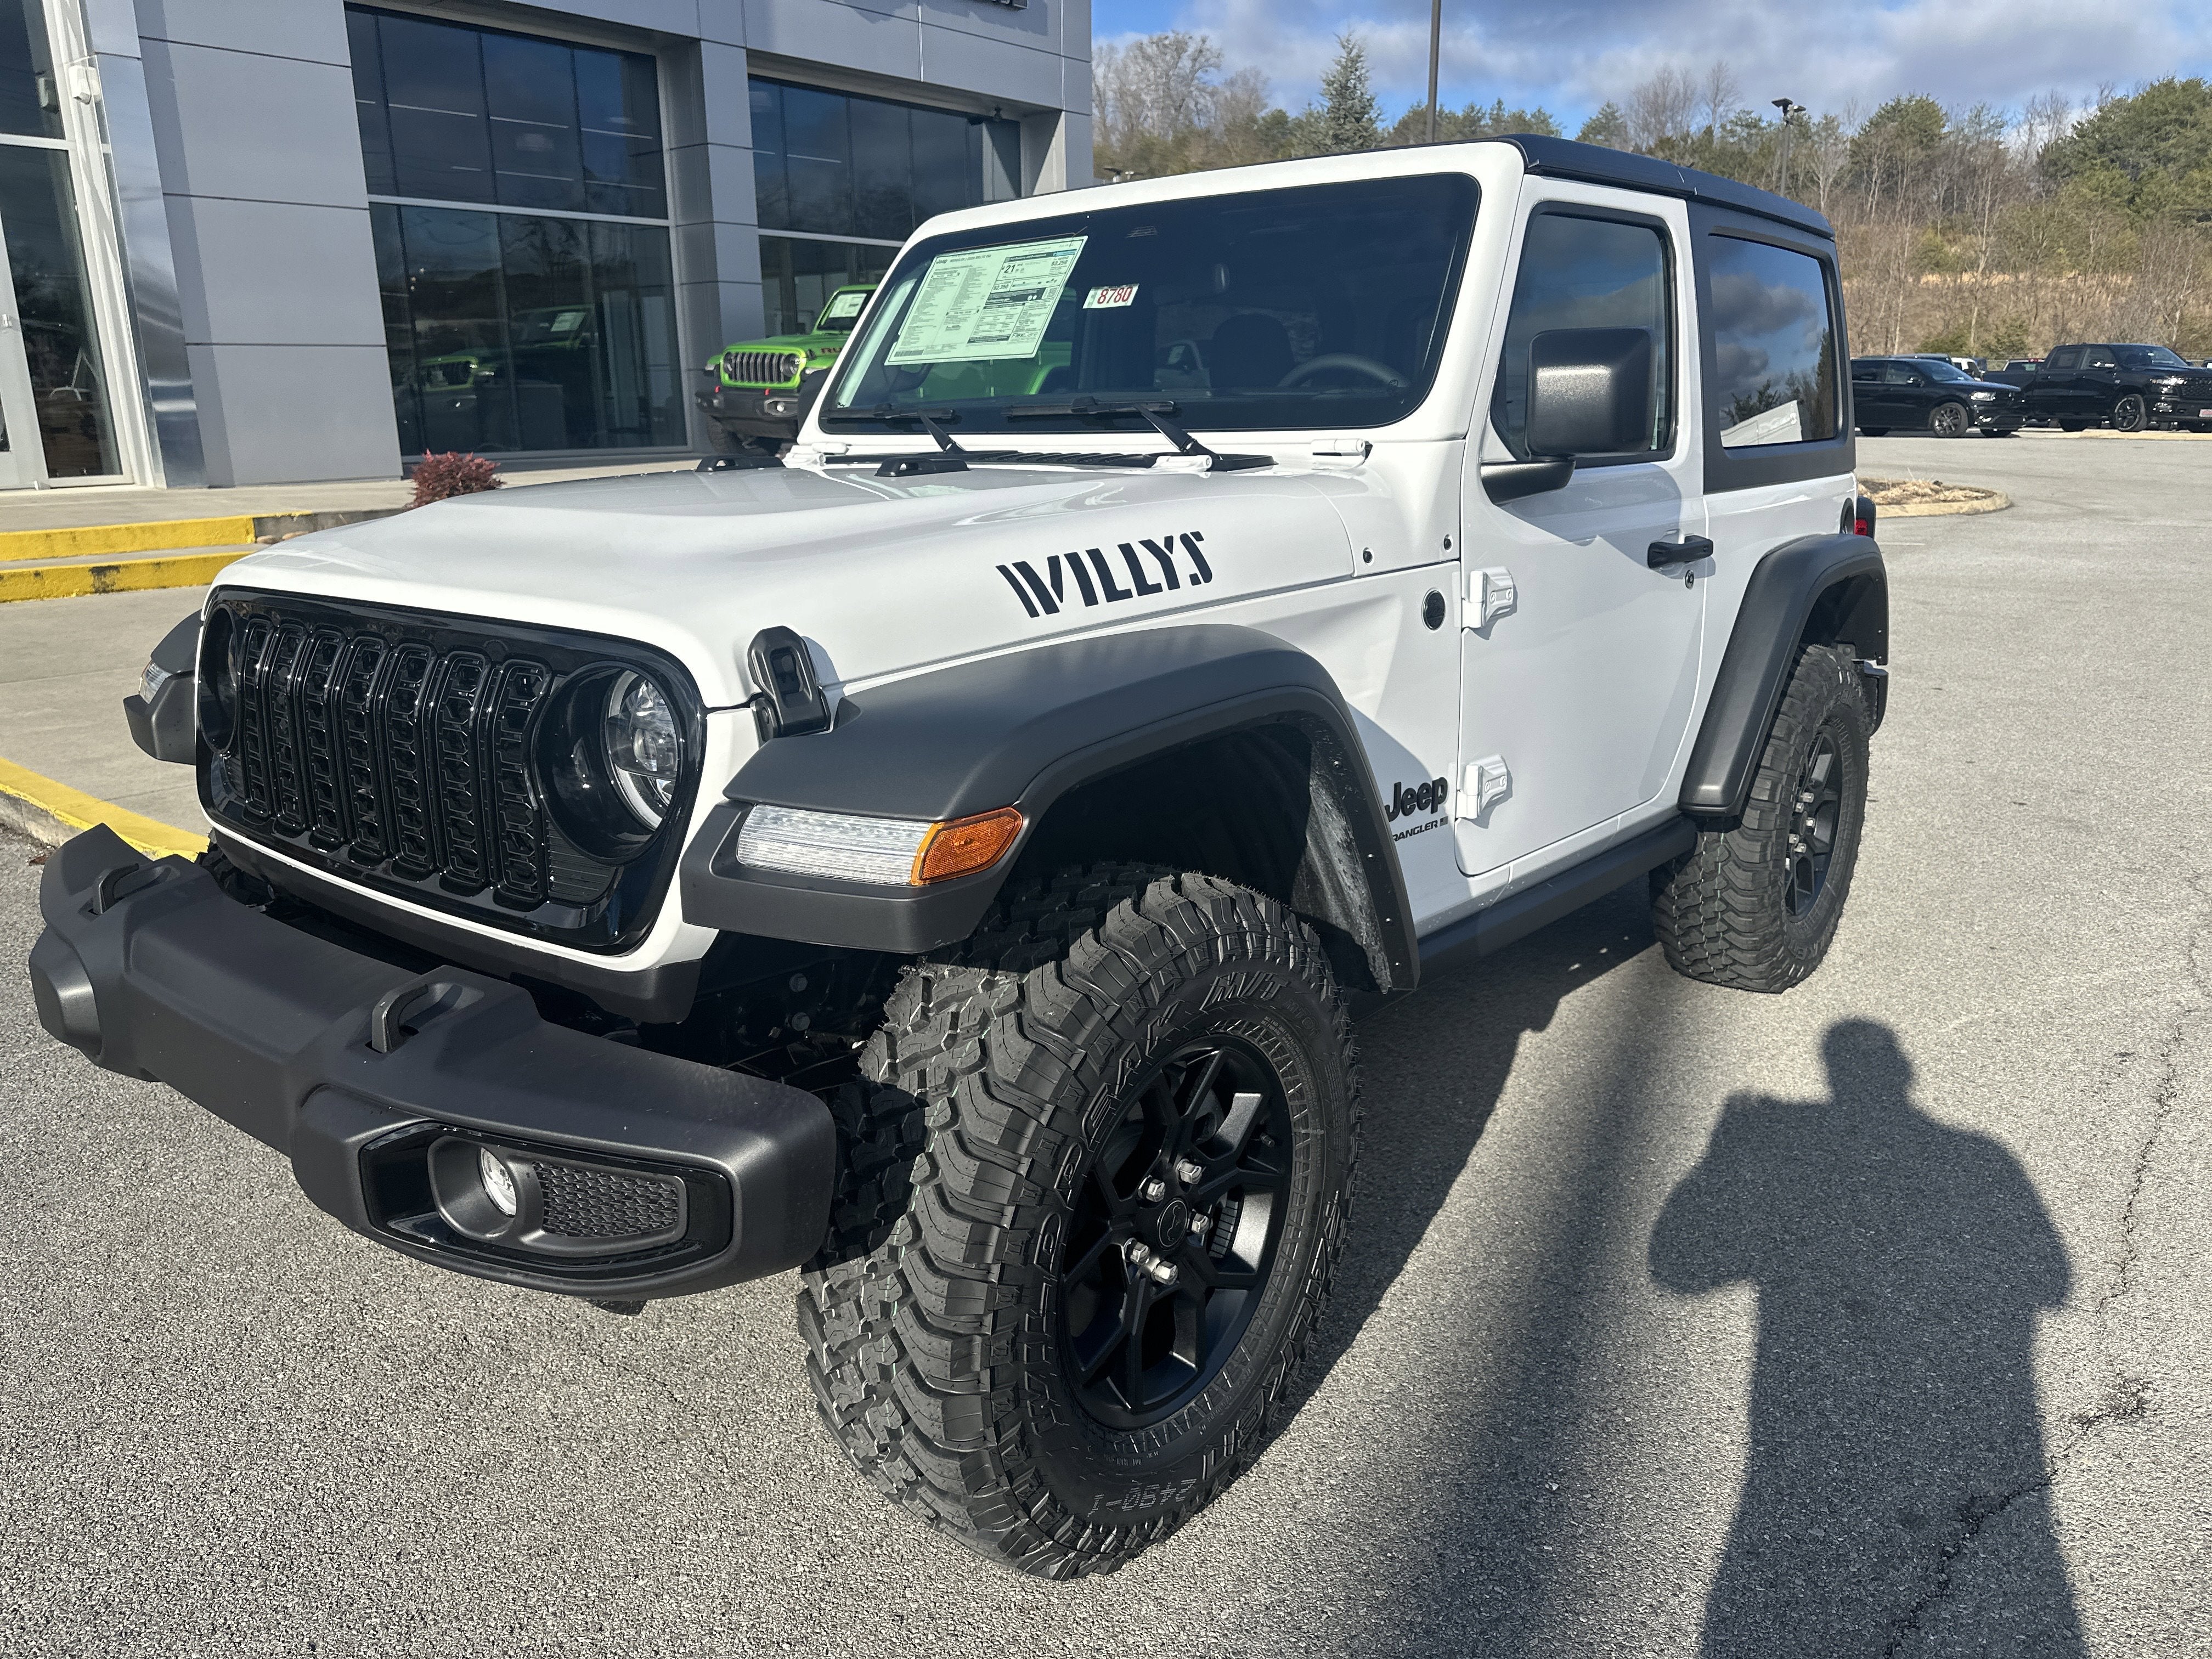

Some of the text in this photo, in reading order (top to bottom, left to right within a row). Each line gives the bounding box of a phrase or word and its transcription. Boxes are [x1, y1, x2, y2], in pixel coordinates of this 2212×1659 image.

[1003, 264, 1016, 274] 21
[1097, 286, 1133, 304] 8780
[995, 531, 1213, 618] WILLYS
[1384, 776, 1448, 822] Jeep
[1392, 820, 1438, 842] RANGLER
